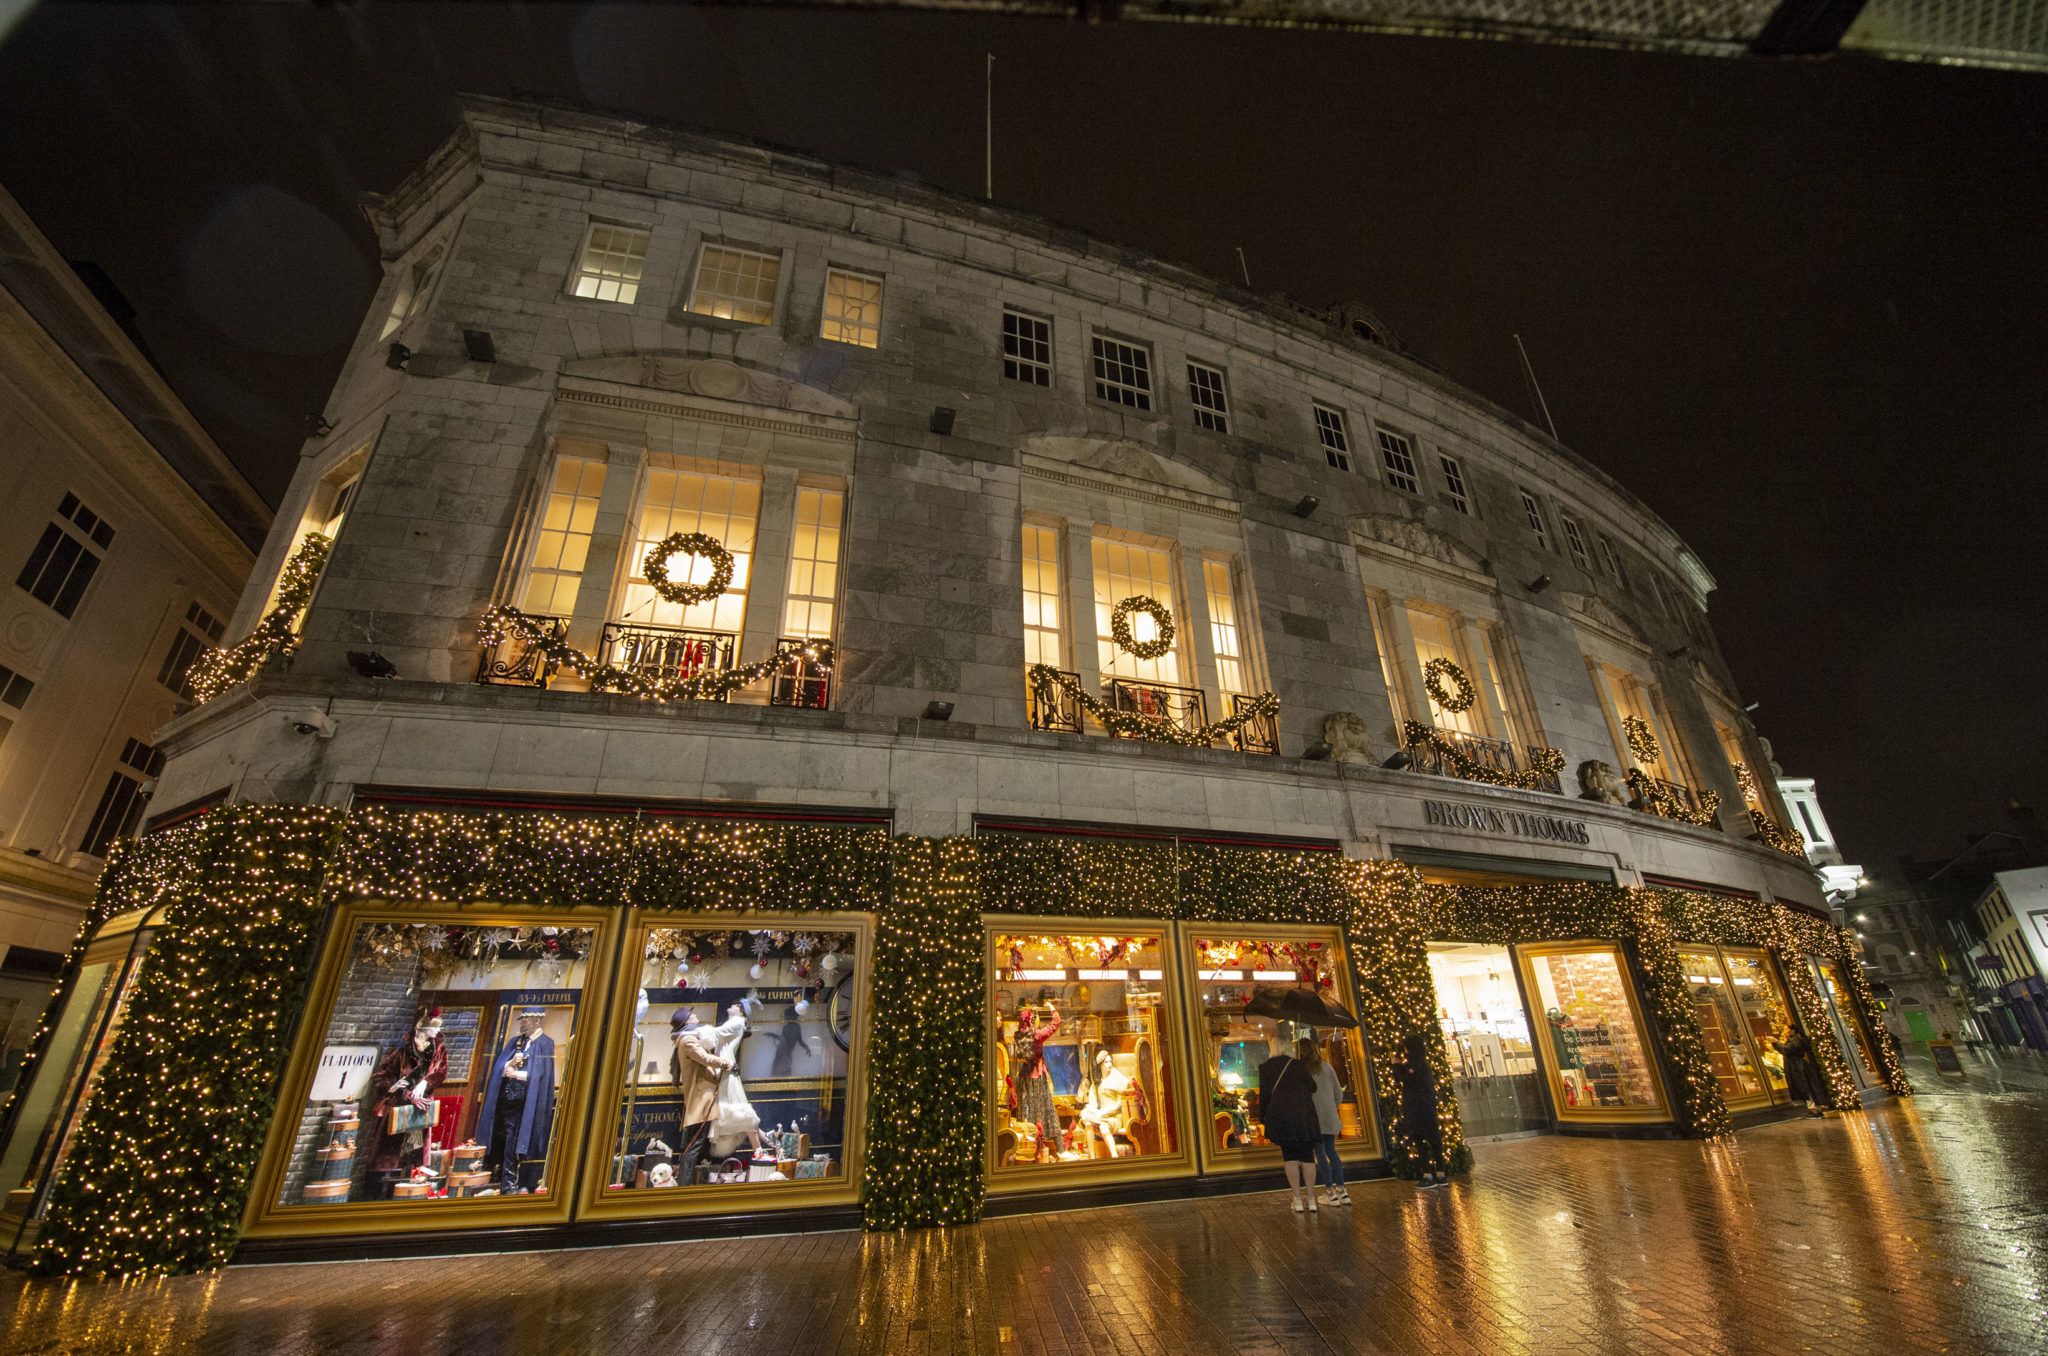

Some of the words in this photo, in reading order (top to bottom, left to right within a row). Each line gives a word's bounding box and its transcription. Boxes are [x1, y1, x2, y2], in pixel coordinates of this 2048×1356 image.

[1425, 800, 1505, 833] BROWN
[1506, 812, 1590, 845] THOMAS
[322, 1055, 374, 1066] PLATFORM
[339, 1070, 348, 1089] 1
